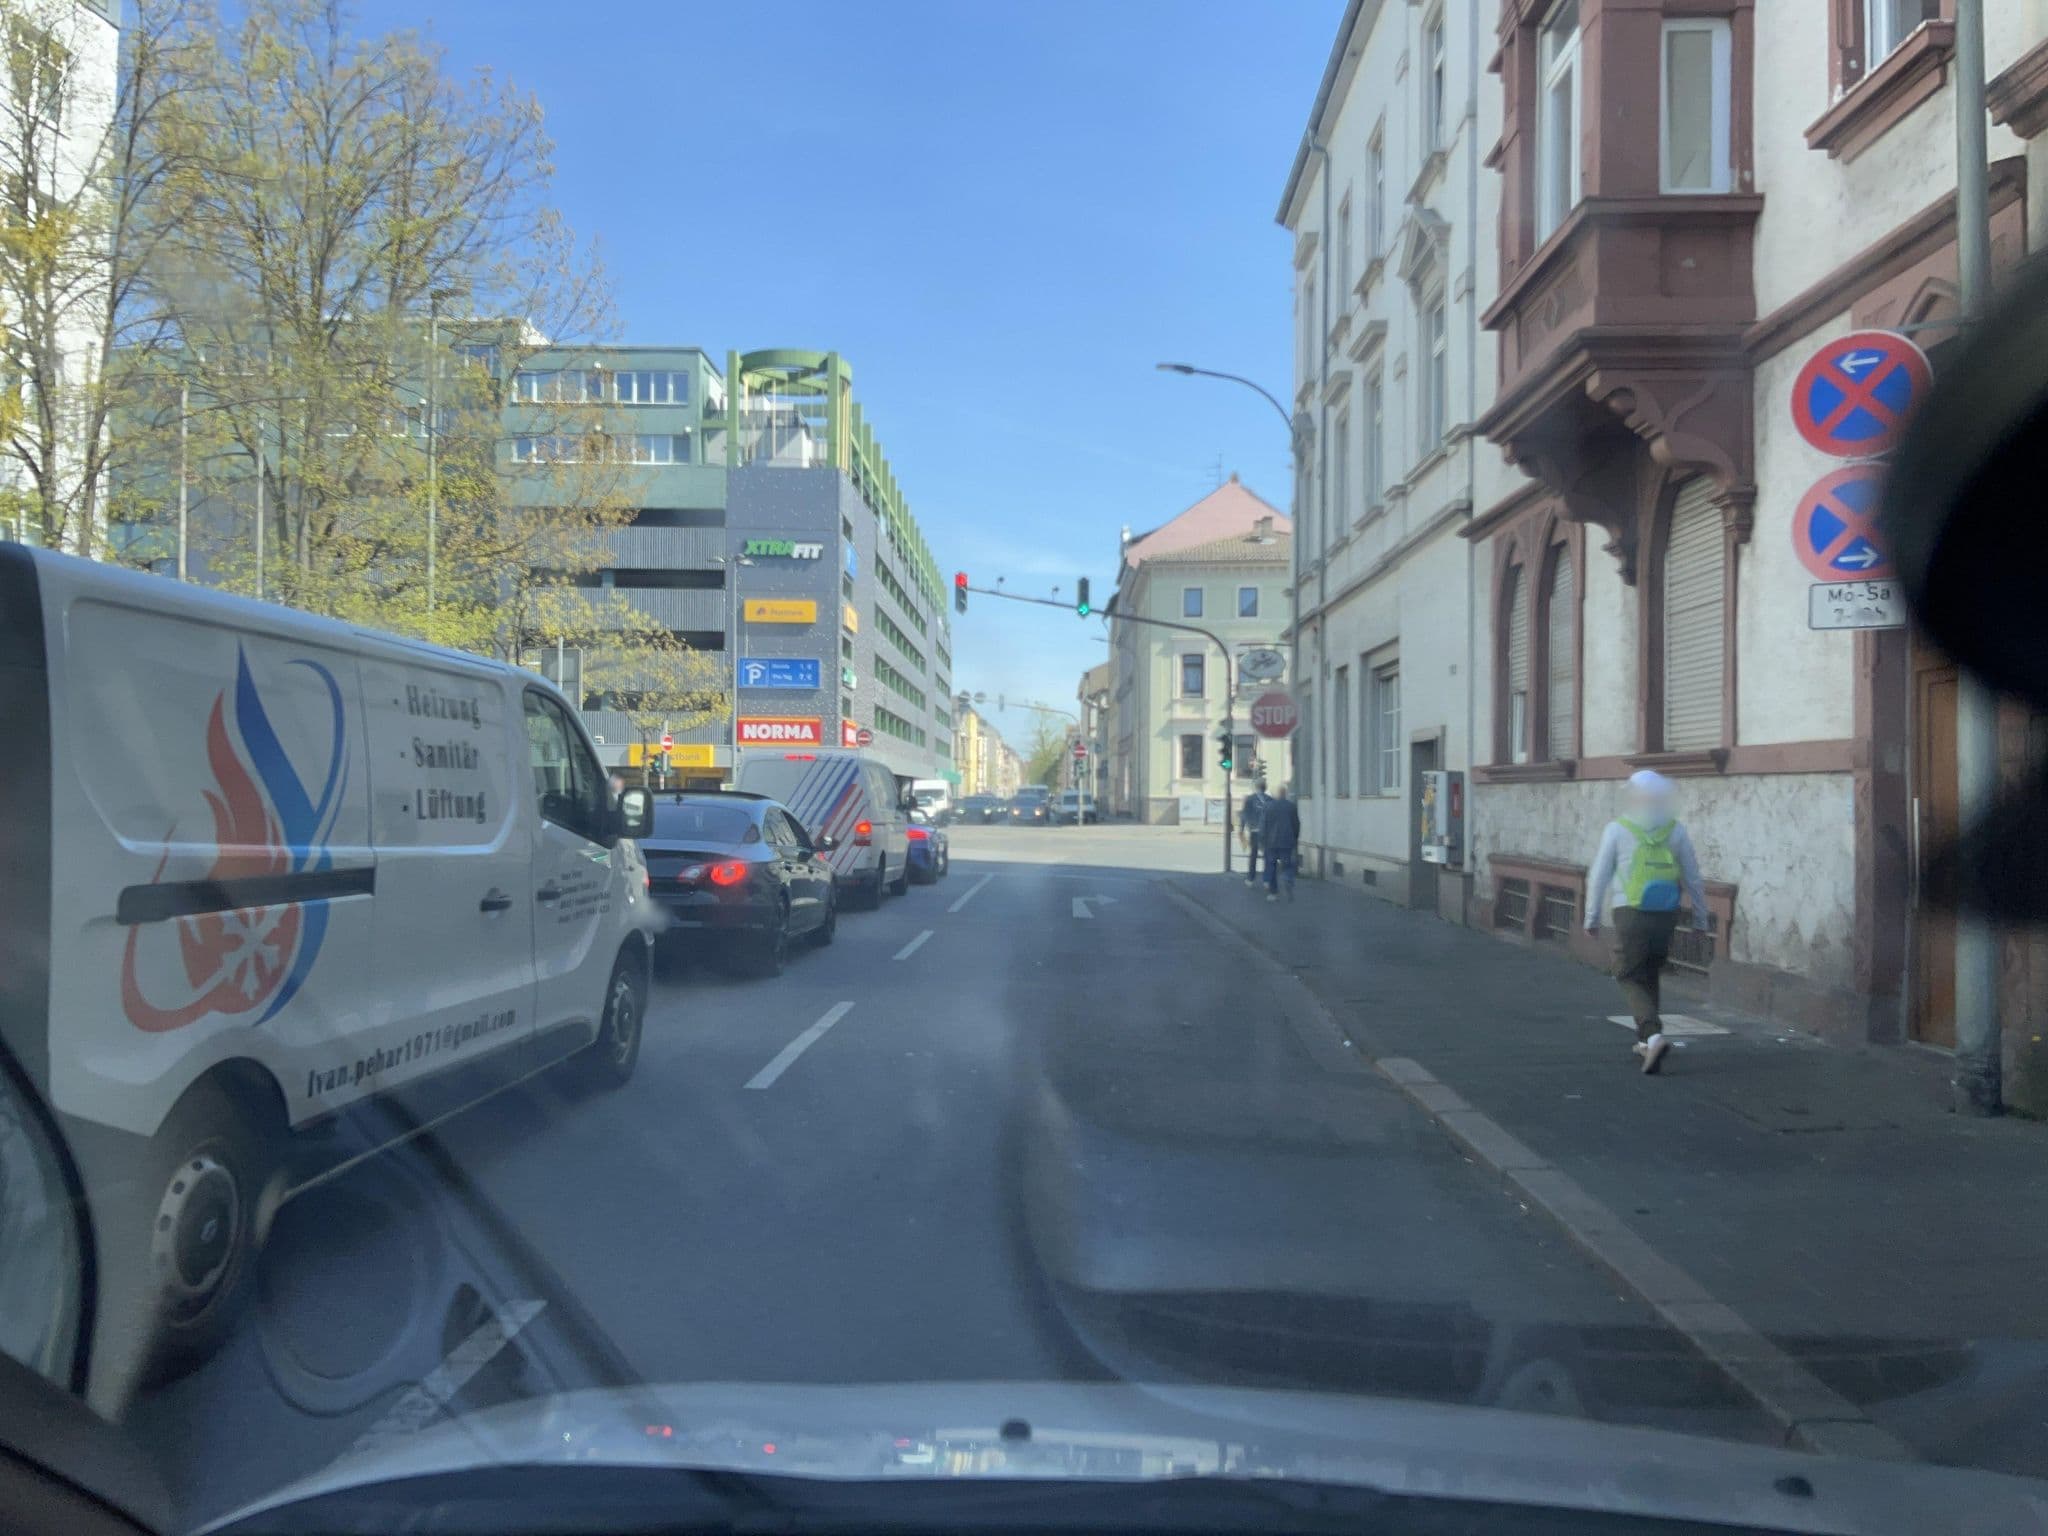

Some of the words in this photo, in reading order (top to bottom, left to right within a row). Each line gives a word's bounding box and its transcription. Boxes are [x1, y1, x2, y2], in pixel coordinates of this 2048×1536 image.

[744, 539, 824, 559] XTRAFIT
[1827, 586, 1890, 602] Mo-Sa
[406, 684, 482, 730] Heizung
[1254, 705, 1298, 726] STOP
[743, 724, 814, 739] NORMA
[412, 736, 479, 769] Sanitär
[416, 788, 486, 824] Lüftung
